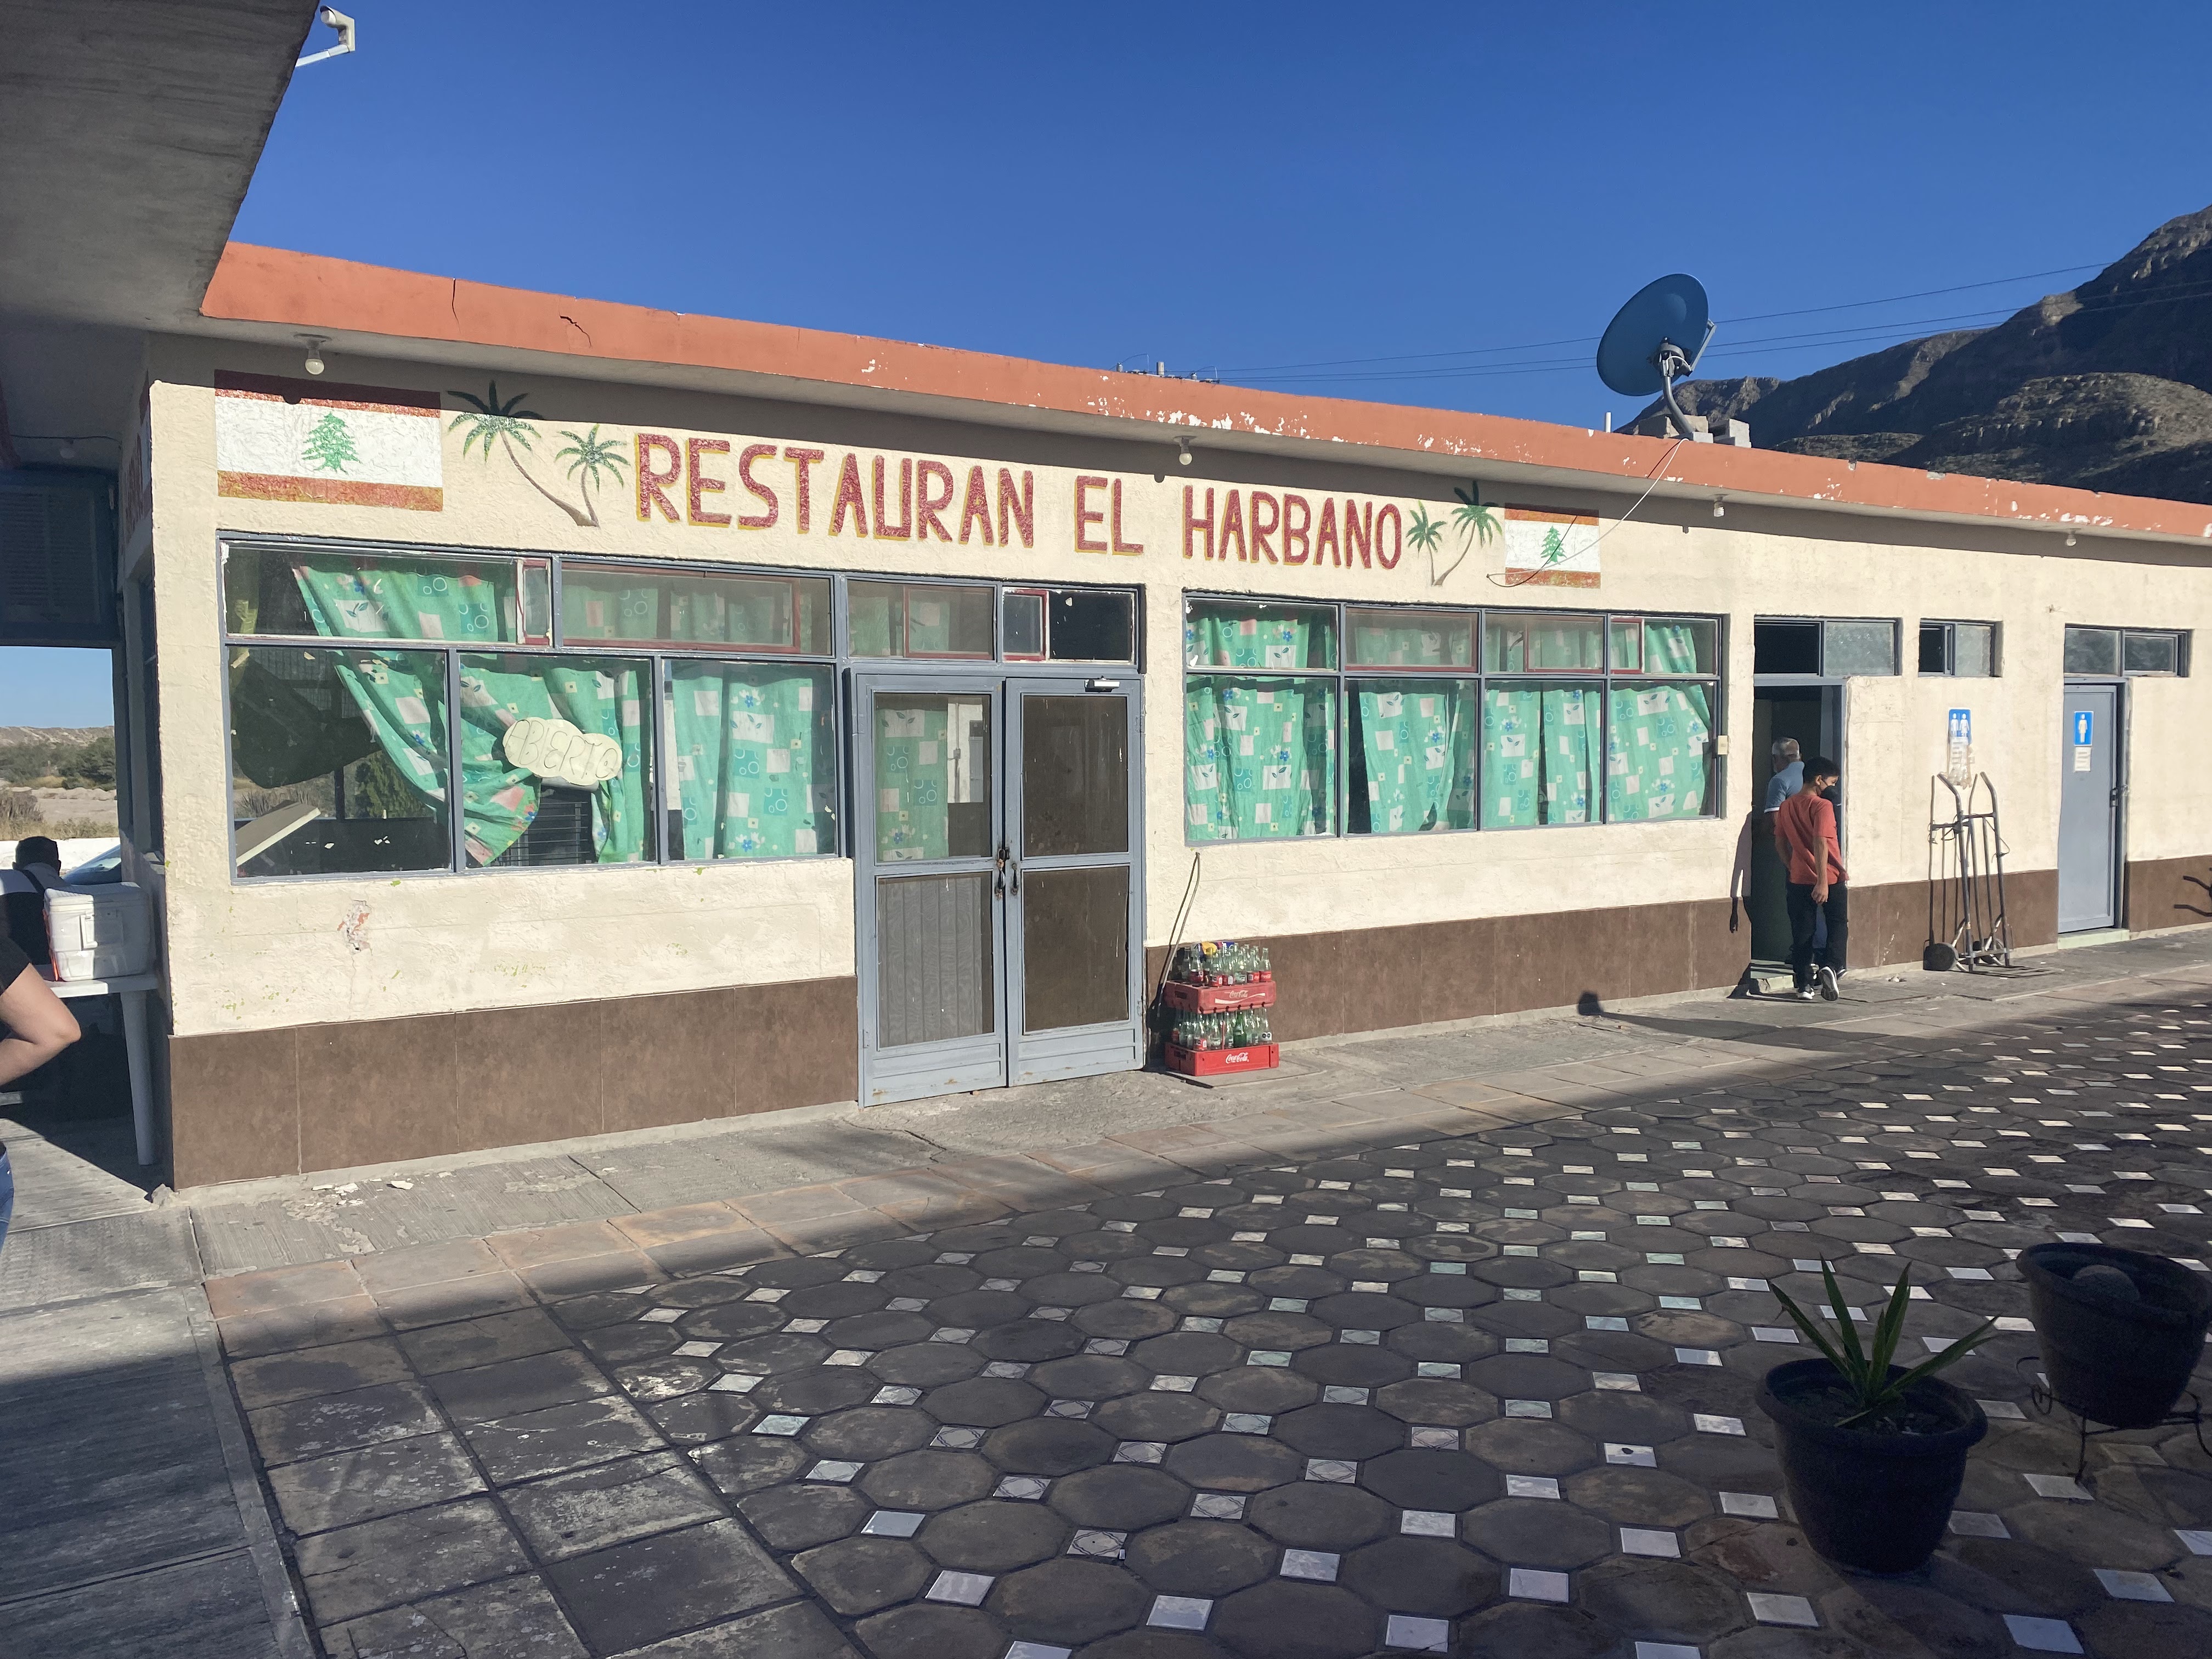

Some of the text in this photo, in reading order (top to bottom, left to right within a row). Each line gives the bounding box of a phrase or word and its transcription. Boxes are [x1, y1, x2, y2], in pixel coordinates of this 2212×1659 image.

[636, 432, 1402, 570] RESTAURAN EL HARBANO
[504, 719, 618, 780] ABIERTO
